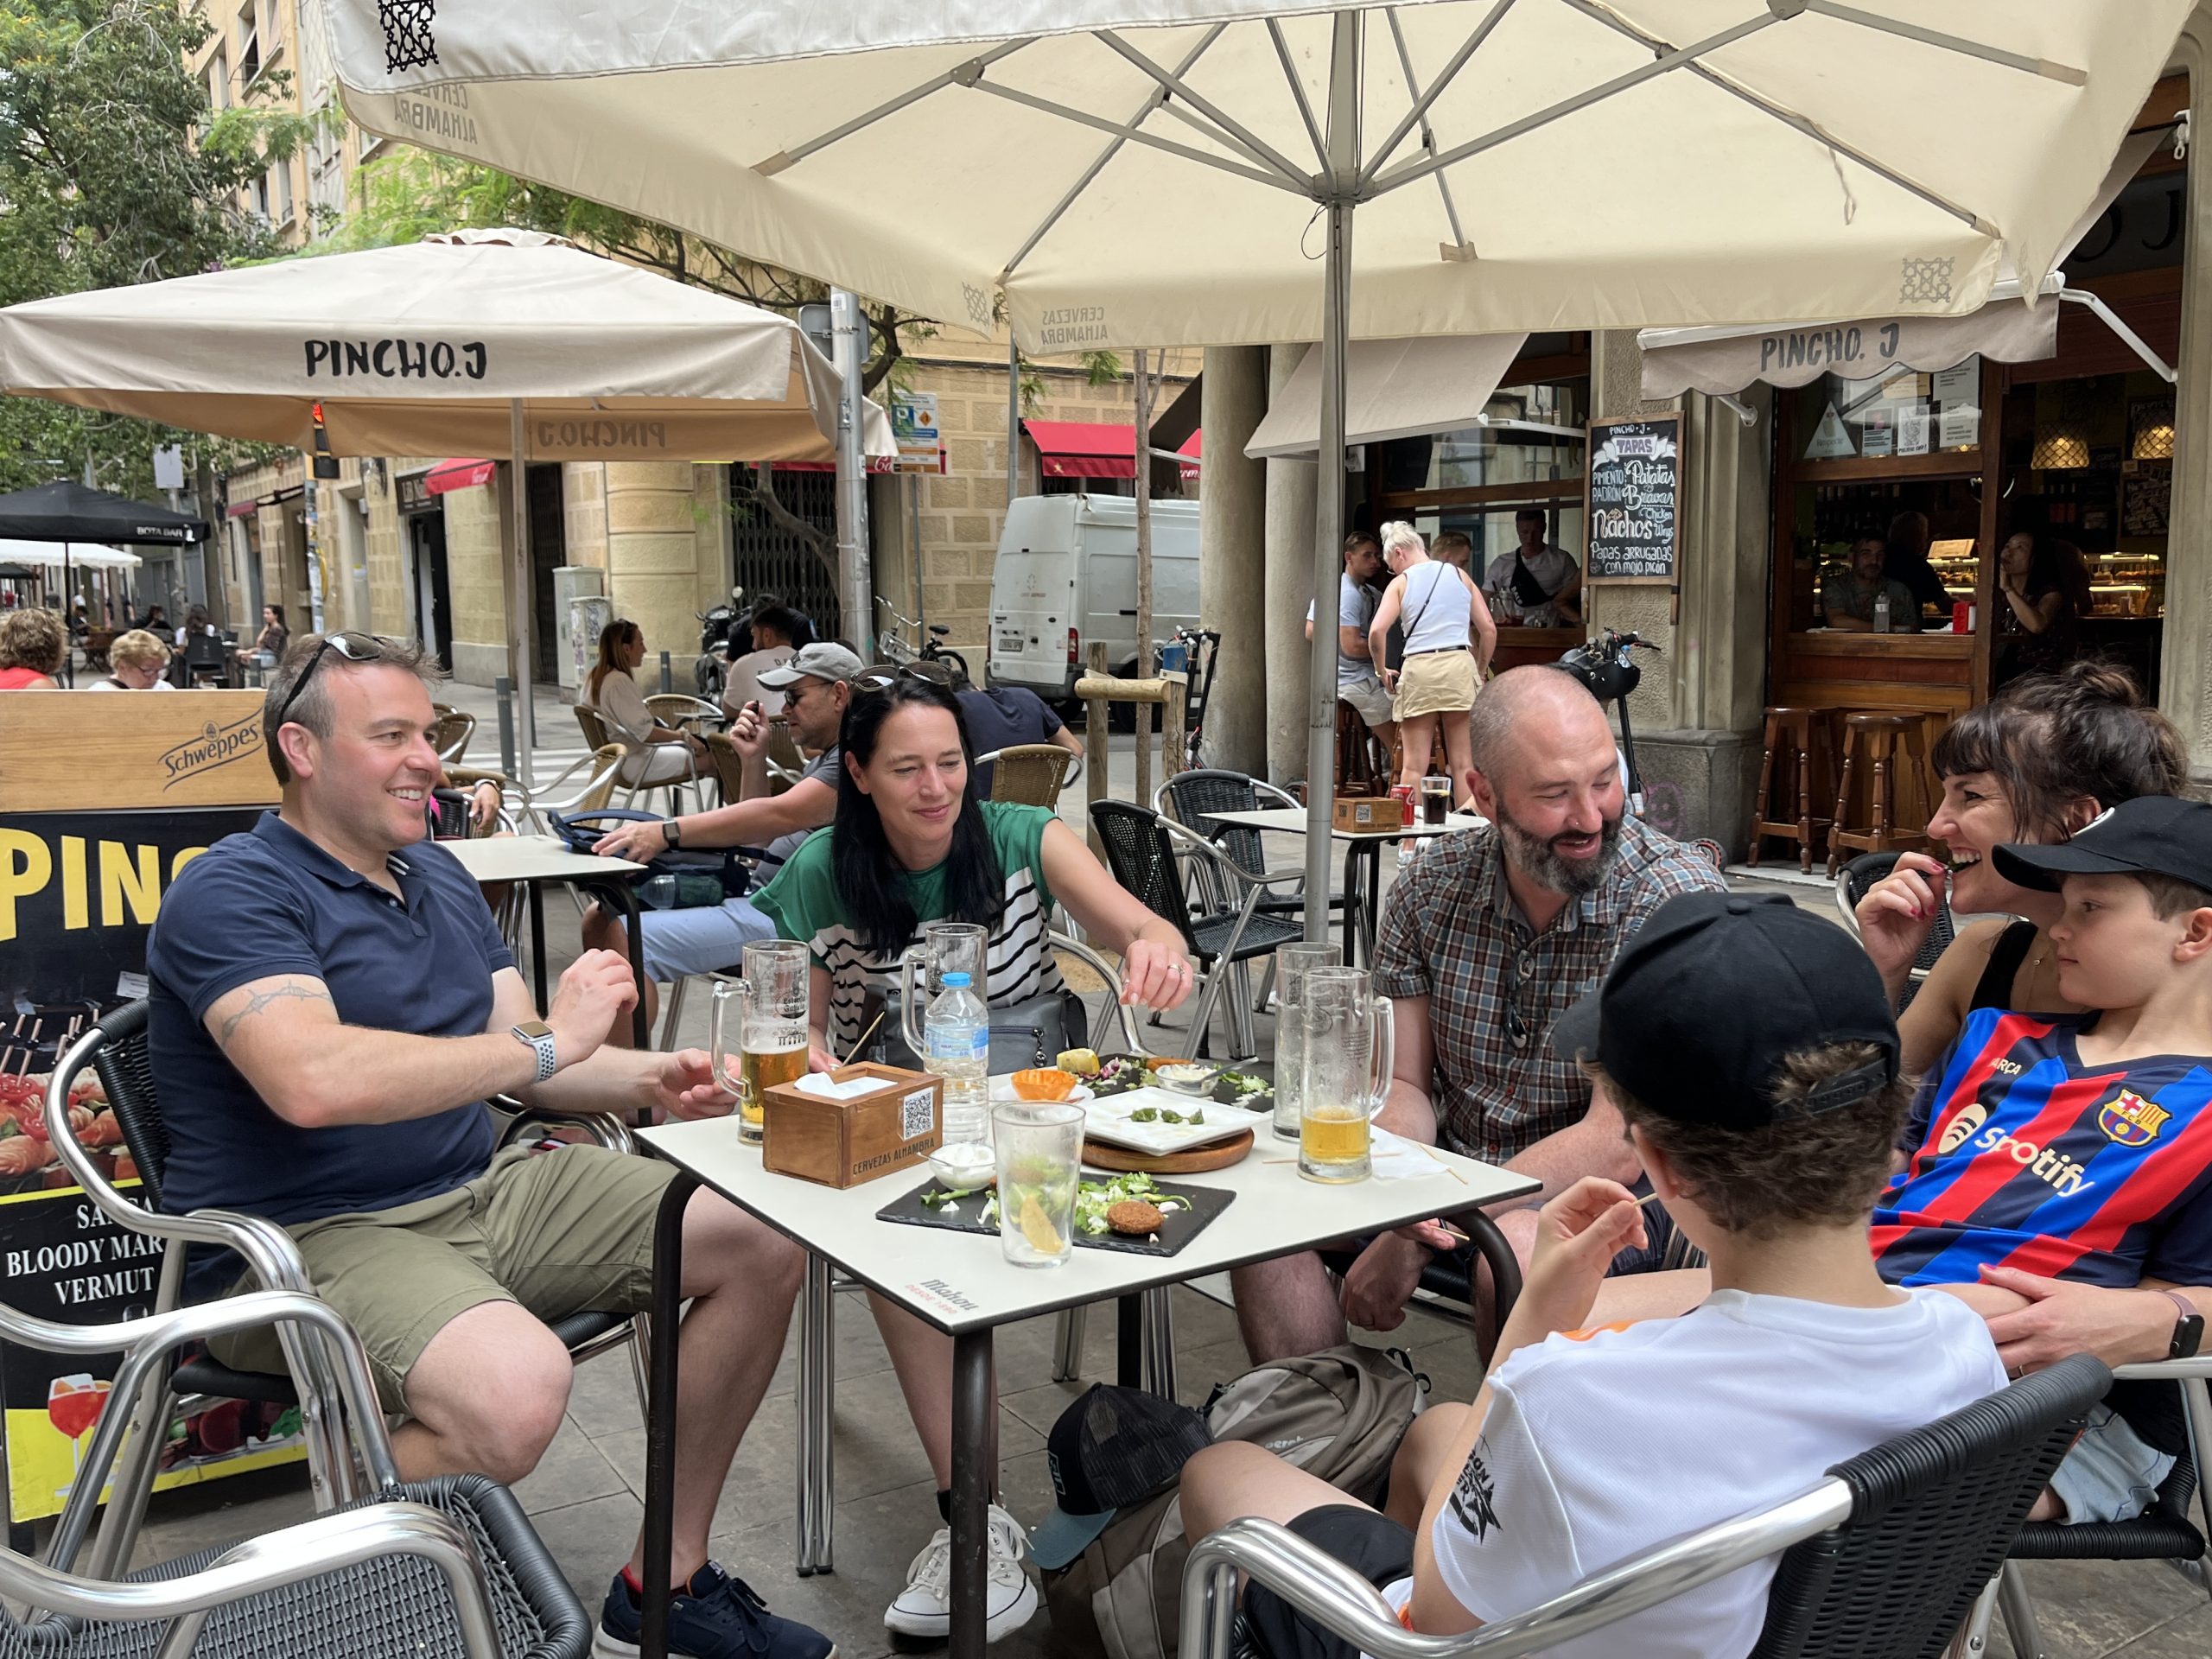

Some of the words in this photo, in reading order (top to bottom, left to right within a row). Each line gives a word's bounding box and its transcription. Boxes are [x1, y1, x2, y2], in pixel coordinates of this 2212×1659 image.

[1879, 322, 1899, 358] J
[304, 339, 486, 379] PINCHO.J
[1617, 439, 1653, 454] TAPAS
[1592, 469, 1624, 485] PIMIENTO
[1625, 460, 1675, 487] Patatas
[1622, 484, 1675, 510] Bravas
[1592, 508, 1653, 539] Nachos
[1590, 541, 1621, 563] Papas
[1605, 561, 1622, 574] con
[164, 722, 260, 779] Schweppes
[853, 1153, 891, 1175] CERVEZAS
[893, 1137, 935, 1161] ALHAMBRA
[1974, 1127, 2095, 1198] Spotify
[7, 1238, 105, 1277] BLOODY
[54, 1267, 155, 1305] VERMUT
[919, 1279, 979, 1310] Mahou
